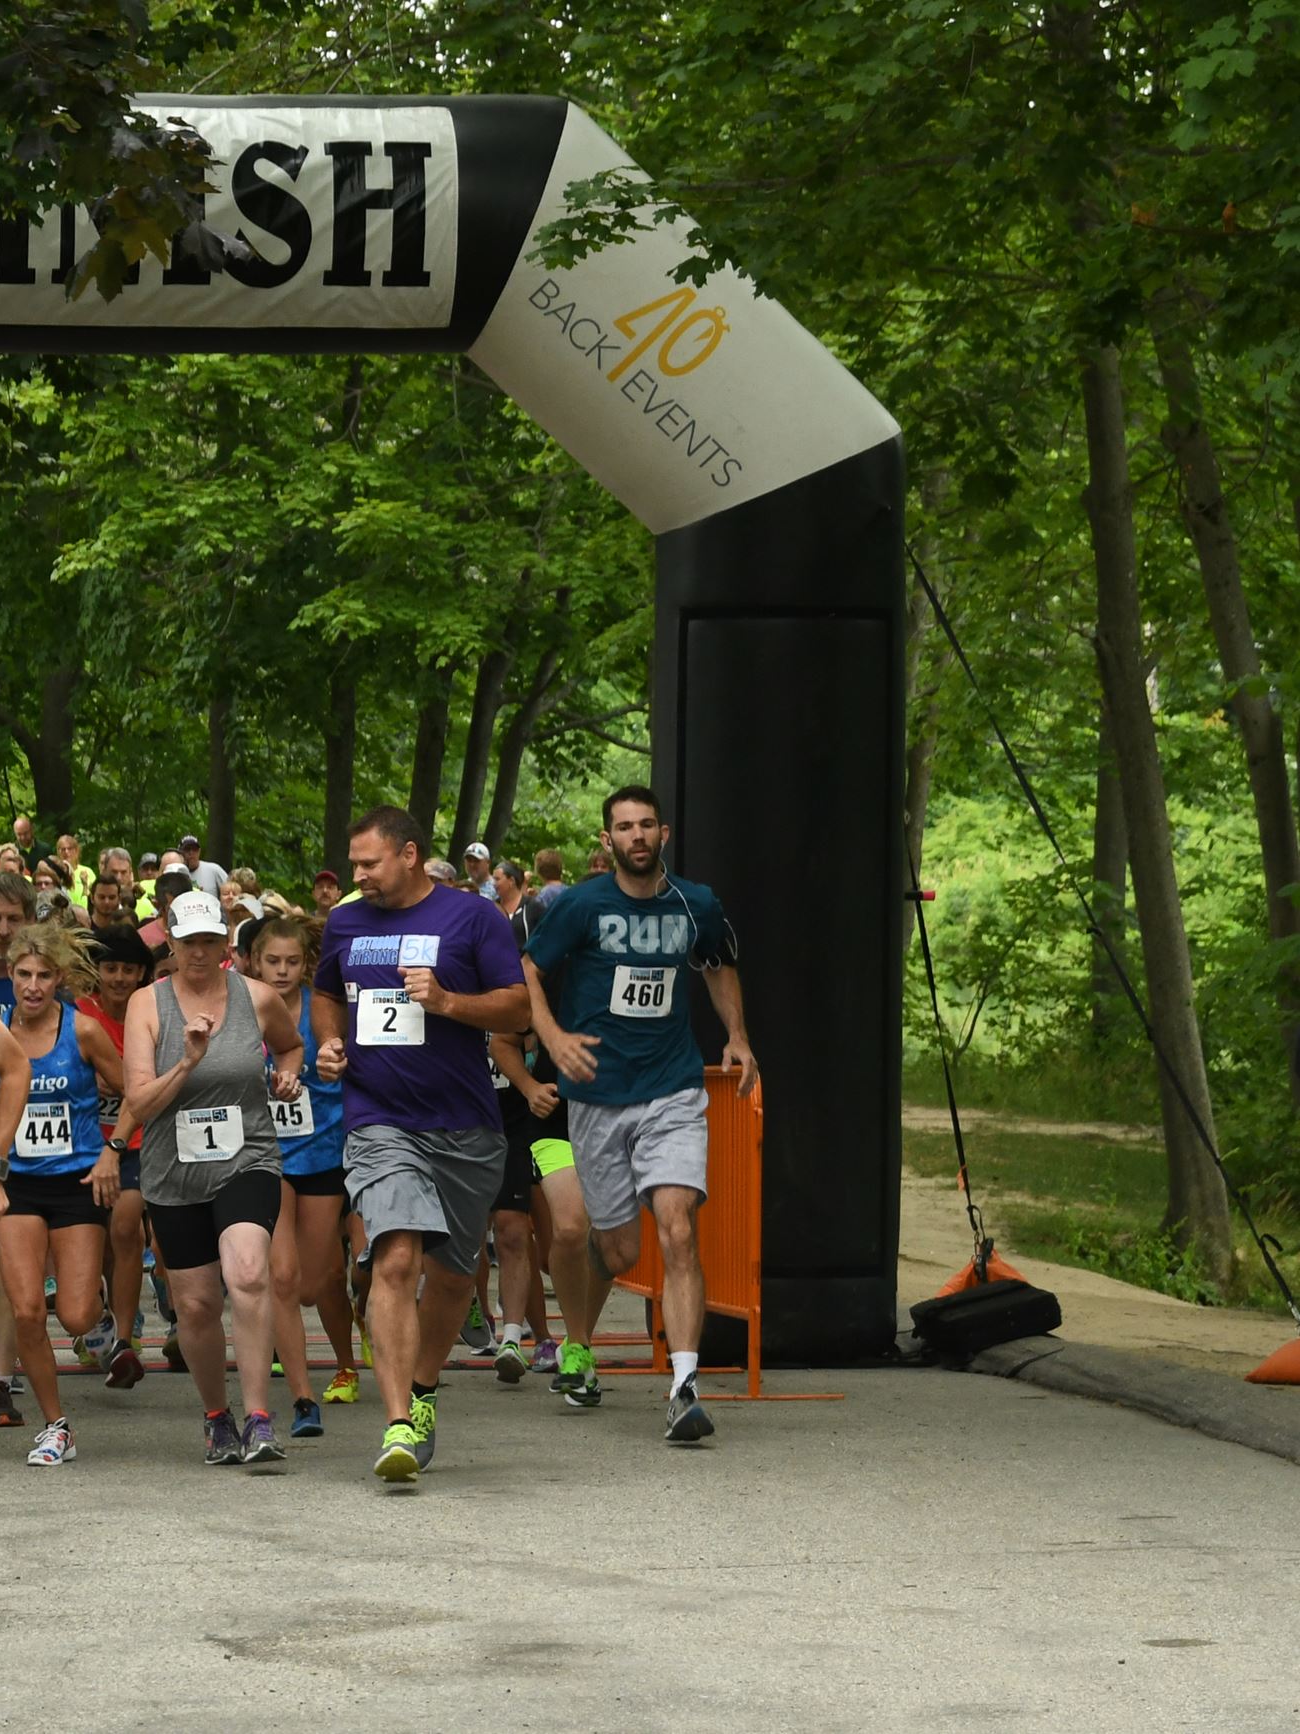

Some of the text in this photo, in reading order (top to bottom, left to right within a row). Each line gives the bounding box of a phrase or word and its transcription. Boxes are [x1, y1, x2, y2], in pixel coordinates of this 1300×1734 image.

[606, 287, 731, 383] 40
[529, 278, 743, 487] BACK EVENTS
[599, 914, 688, 954] RUN
[348, 949, 398, 966] STRONG
[622, 983, 665, 1007] 460
[382, 1006, 398, 1033] 2
[212, 1109, 227, 1121] 5k
[267, 1103, 303, 1126] 45
[25, 1120, 71, 1145] 444
[203, 1125, 218, 1150] 1
